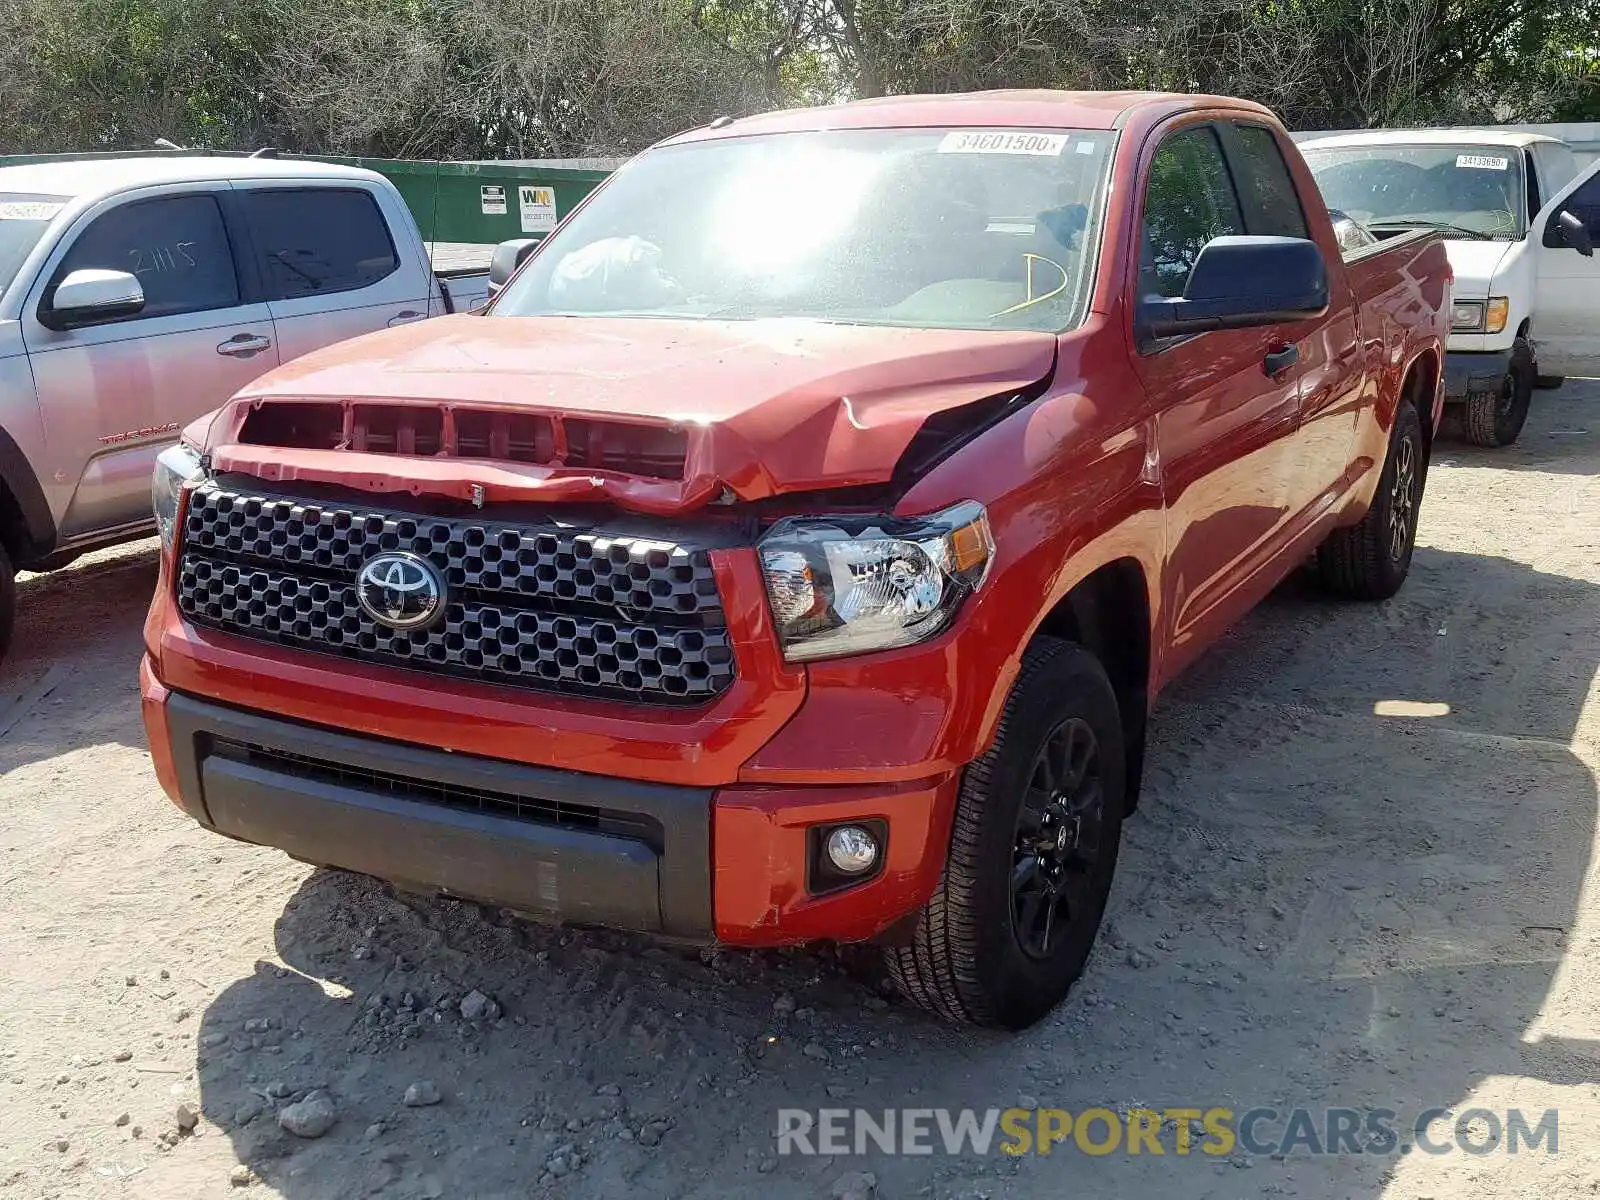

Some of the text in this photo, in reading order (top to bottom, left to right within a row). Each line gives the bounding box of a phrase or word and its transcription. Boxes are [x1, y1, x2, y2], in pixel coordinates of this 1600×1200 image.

[522, 190, 552, 204] WM
[989, 253, 1068, 318] D
[97, 422, 179, 445] TACOMA
